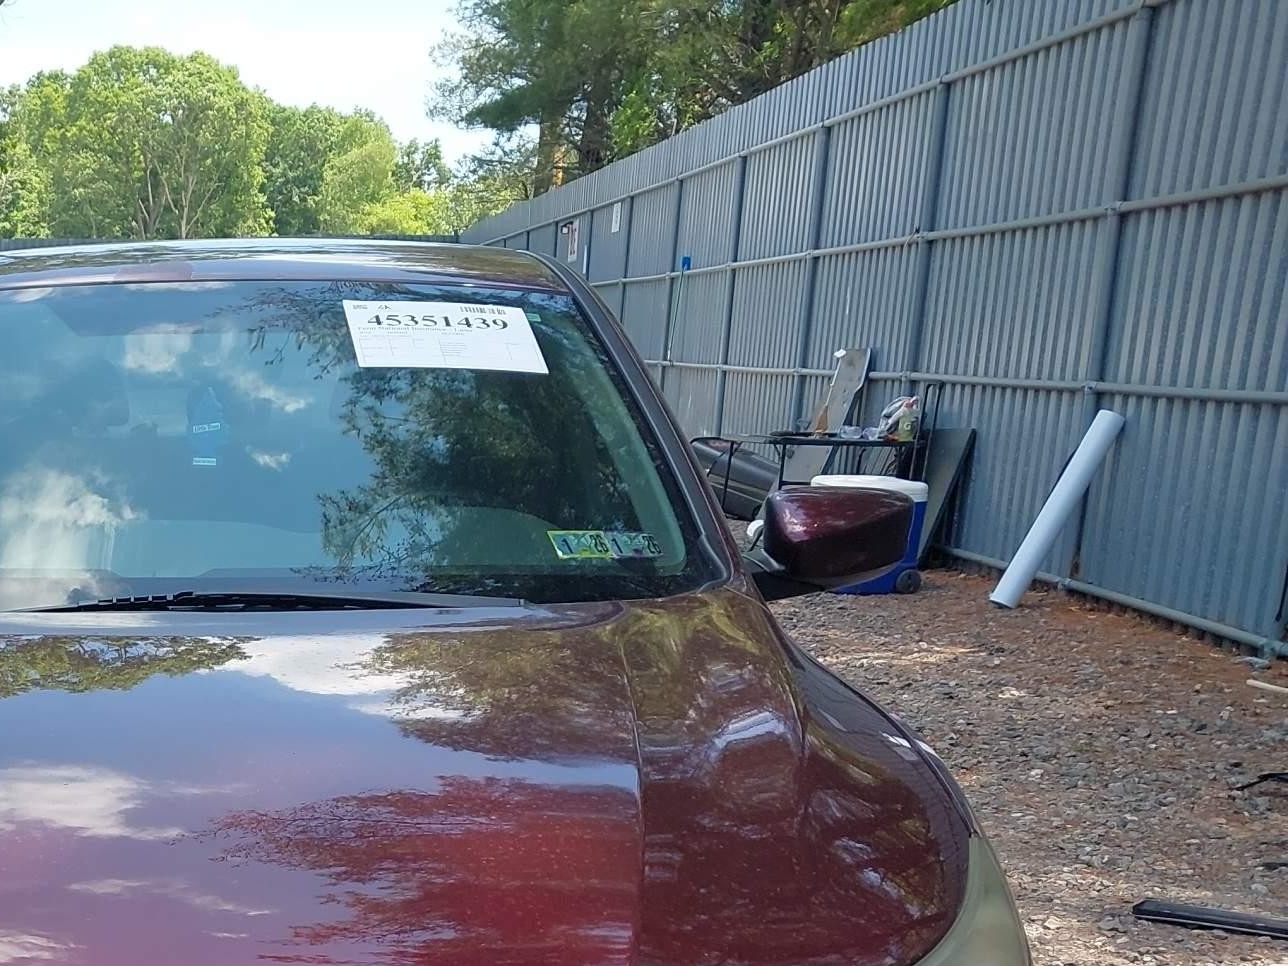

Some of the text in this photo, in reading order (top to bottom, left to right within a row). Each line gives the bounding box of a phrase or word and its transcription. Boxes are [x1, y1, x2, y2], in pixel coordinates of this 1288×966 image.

[367, 314, 509, 330] 45351439
[903, 422, 911, 430] G
[561, 534, 610, 554] 1 26
[611, 535, 662, 554] 1 26
